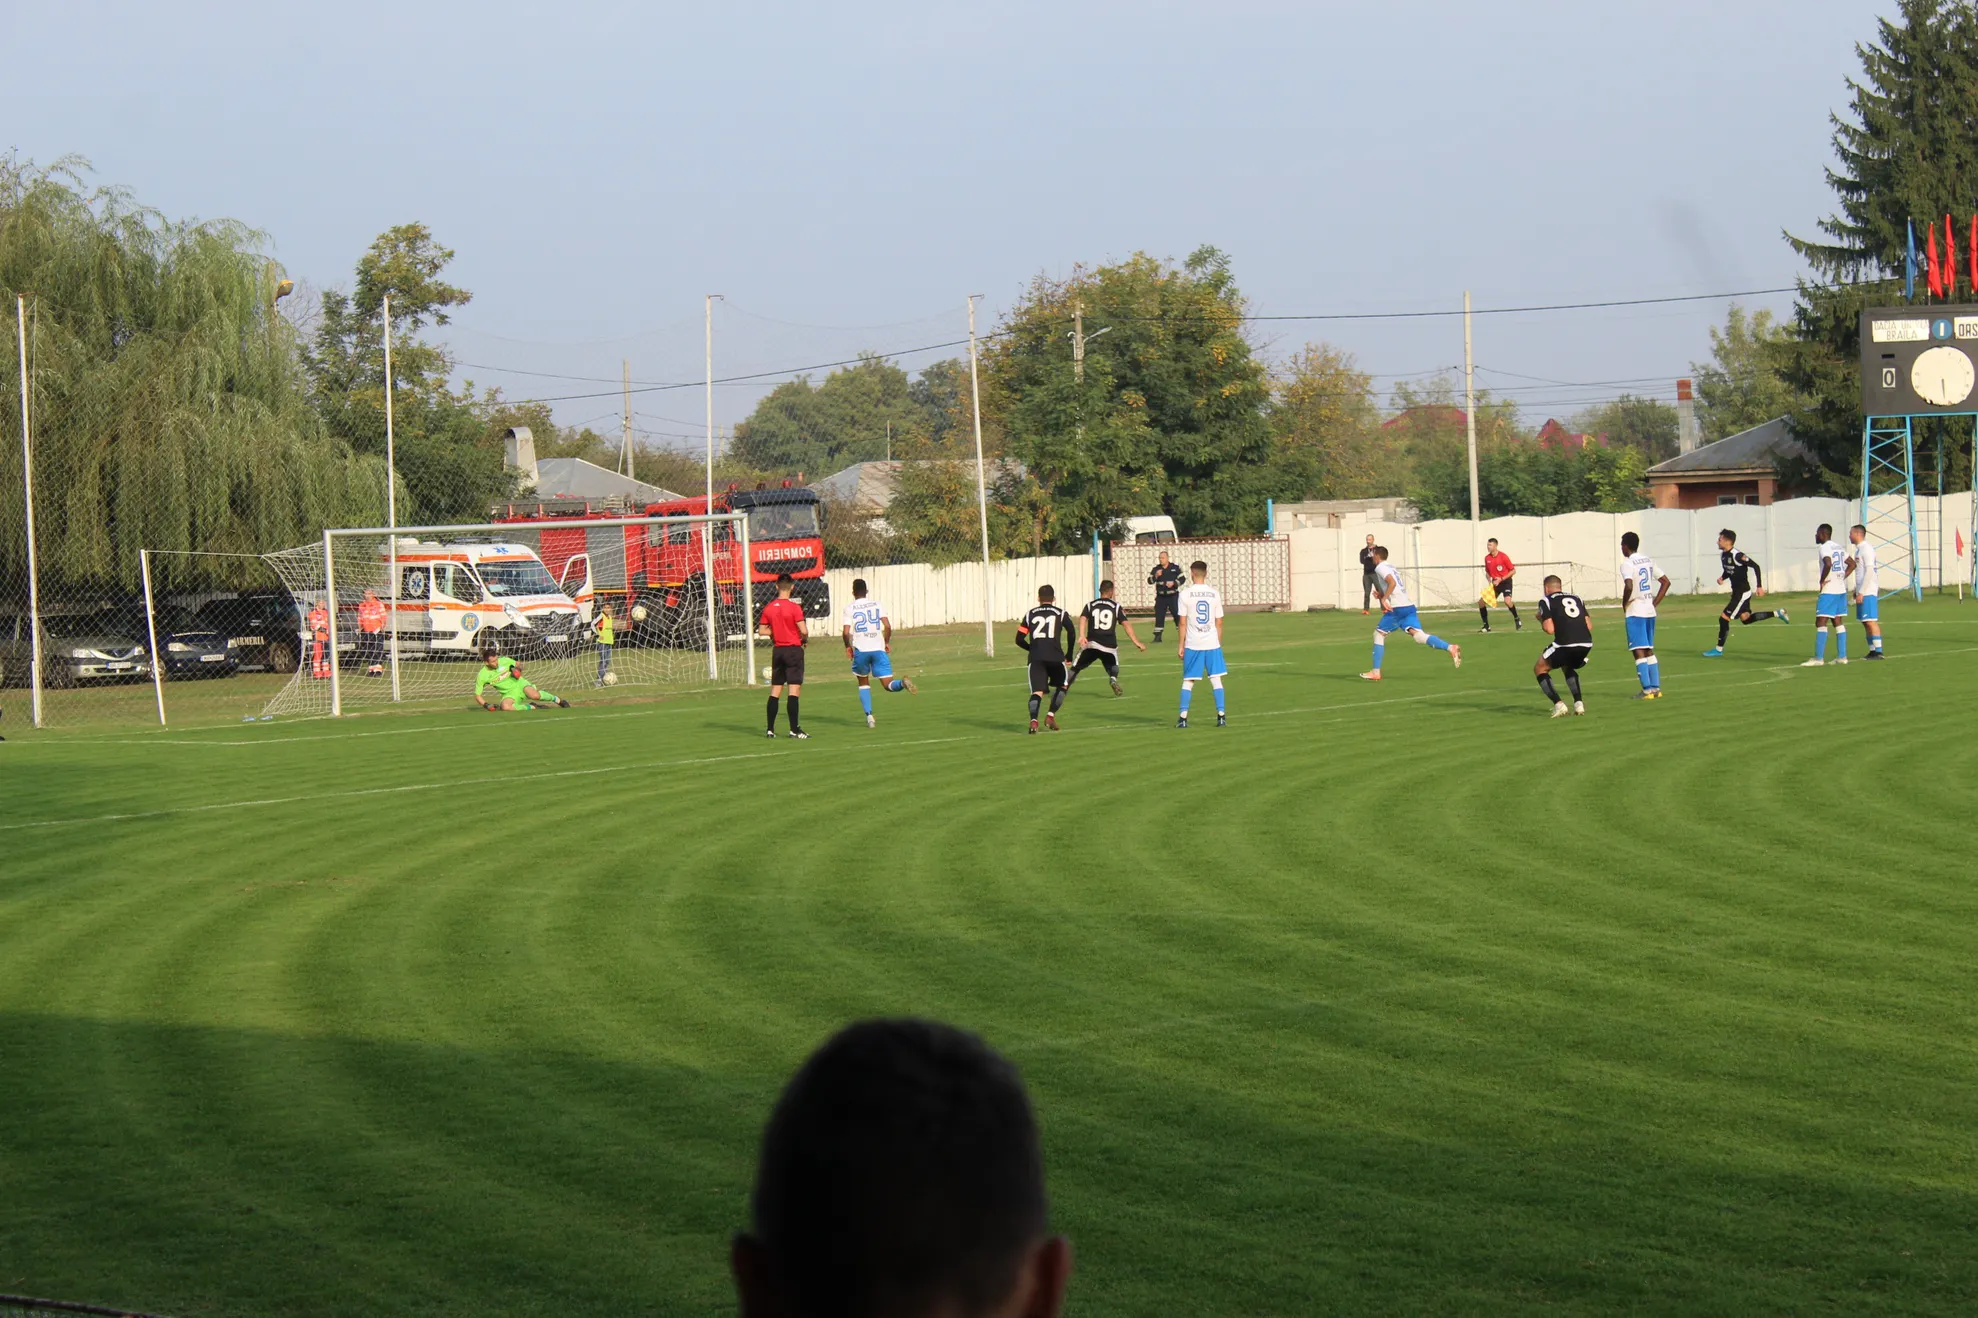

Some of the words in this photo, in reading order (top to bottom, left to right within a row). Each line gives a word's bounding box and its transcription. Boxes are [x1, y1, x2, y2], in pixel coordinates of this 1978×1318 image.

[1874, 321, 1897, 330] DACIA
[1886, 330, 1918, 340] BRAILA
[1092, 607, 1113, 630] 19
[1196, 600, 1210, 624] 9
[1561, 597, 1580, 618] 8
[853, 608, 881, 633] 24
[1031, 615, 1055, 639] 21
